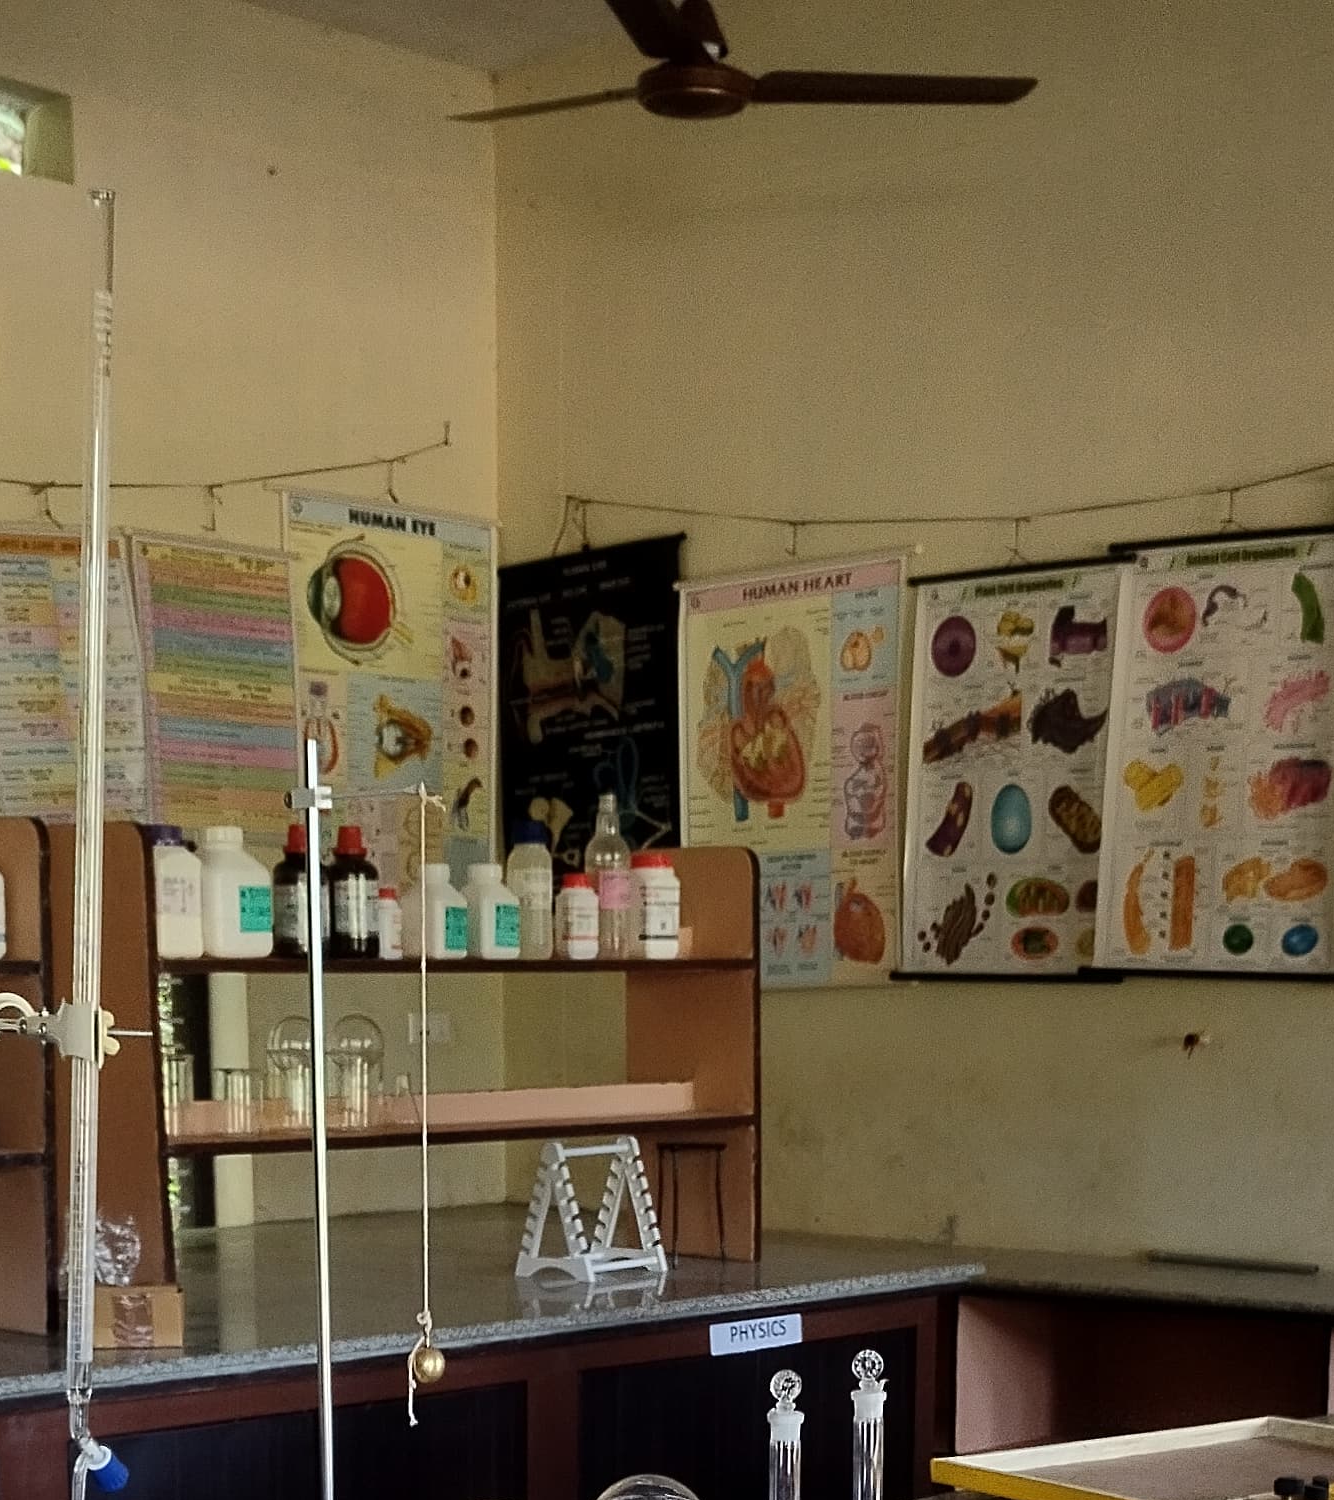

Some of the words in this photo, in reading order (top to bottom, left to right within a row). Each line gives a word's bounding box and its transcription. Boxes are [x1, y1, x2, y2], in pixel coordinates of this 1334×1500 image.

[348, 507, 408, 532] HUMAN
[410, 518, 437, 538] EYE
[743, 580, 799, 601] HUMAN
[803, 571, 853, 592] HEART
[729, 1319, 787, 1343] PHYSICS
